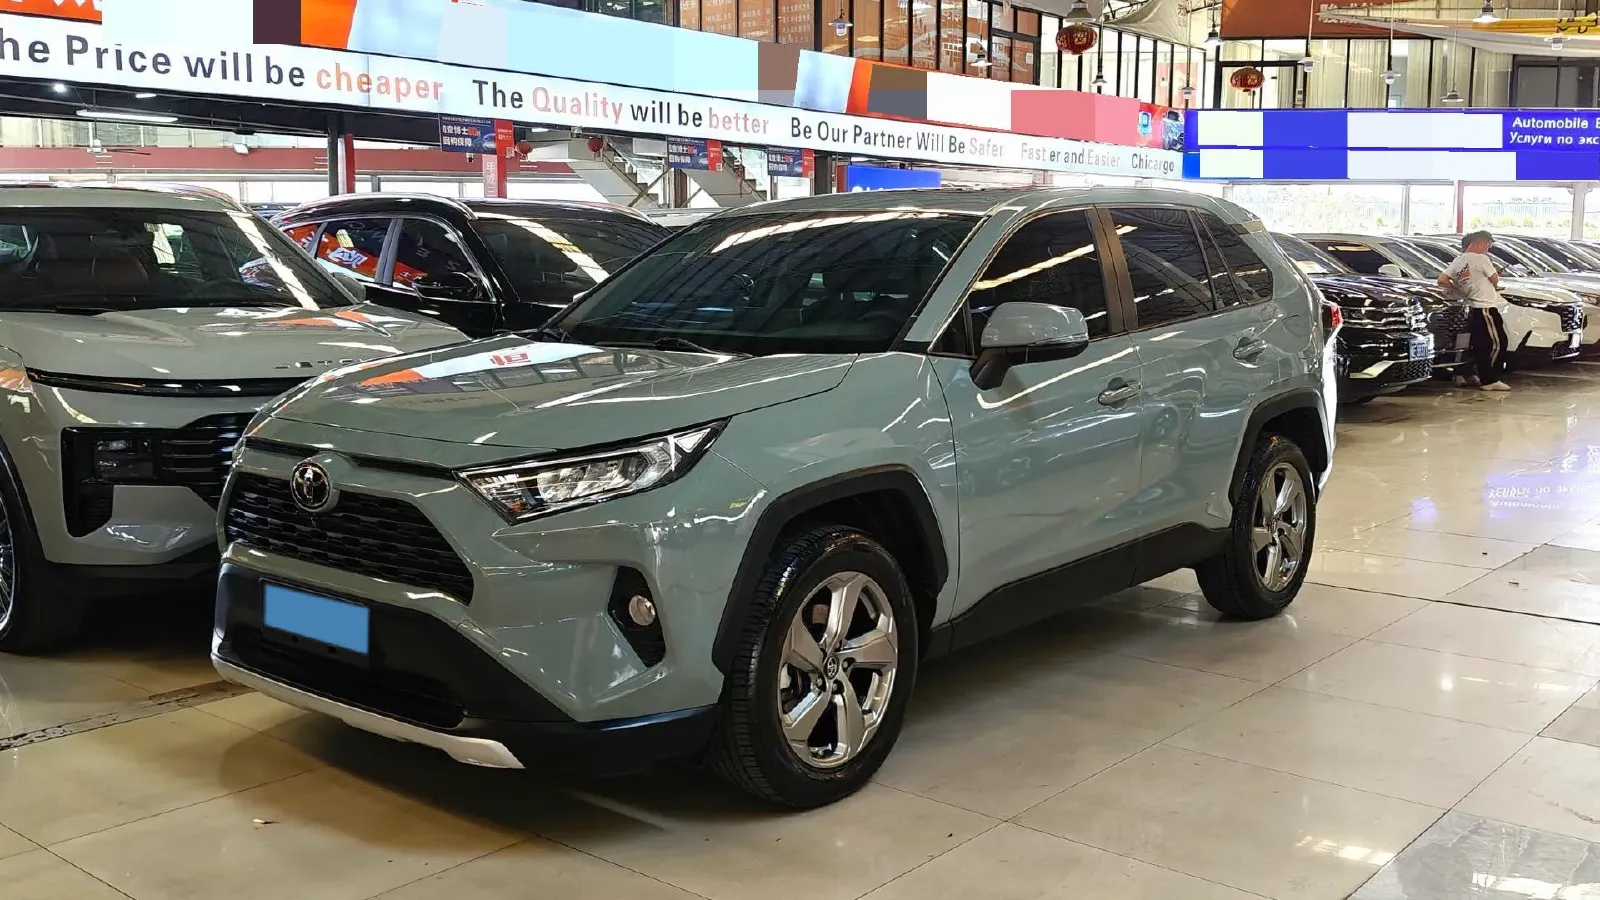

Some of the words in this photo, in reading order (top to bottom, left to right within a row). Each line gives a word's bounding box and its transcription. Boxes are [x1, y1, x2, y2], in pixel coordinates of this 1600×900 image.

[66, 34, 171, 75] Price
[183, 50, 252, 83] will
[265, 55, 305, 87] be
[316, 62, 443, 103] cheaper
[472, 79, 523, 109] The
[532, 86, 623, 124] Quality
[630, 100, 670, 124] will
[678, 103, 703, 128] be
[708, 107, 769, 135] better
[791, 117, 812, 139] Be
[817, 121, 848, 143] Our
[853, 125, 912, 149] Partner
[916, 131, 944, 153] Will
[948, 135, 965, 154] Be
[968, 137, 1004, 158] Safer
[1512, 116, 1589, 129] Automobile
[1509, 131, 1552, 146] Услуги
[1557, 136, 1573, 145] по
[1063, 149, 1084, 165] and
[1087, 150, 1120, 169] Easier
